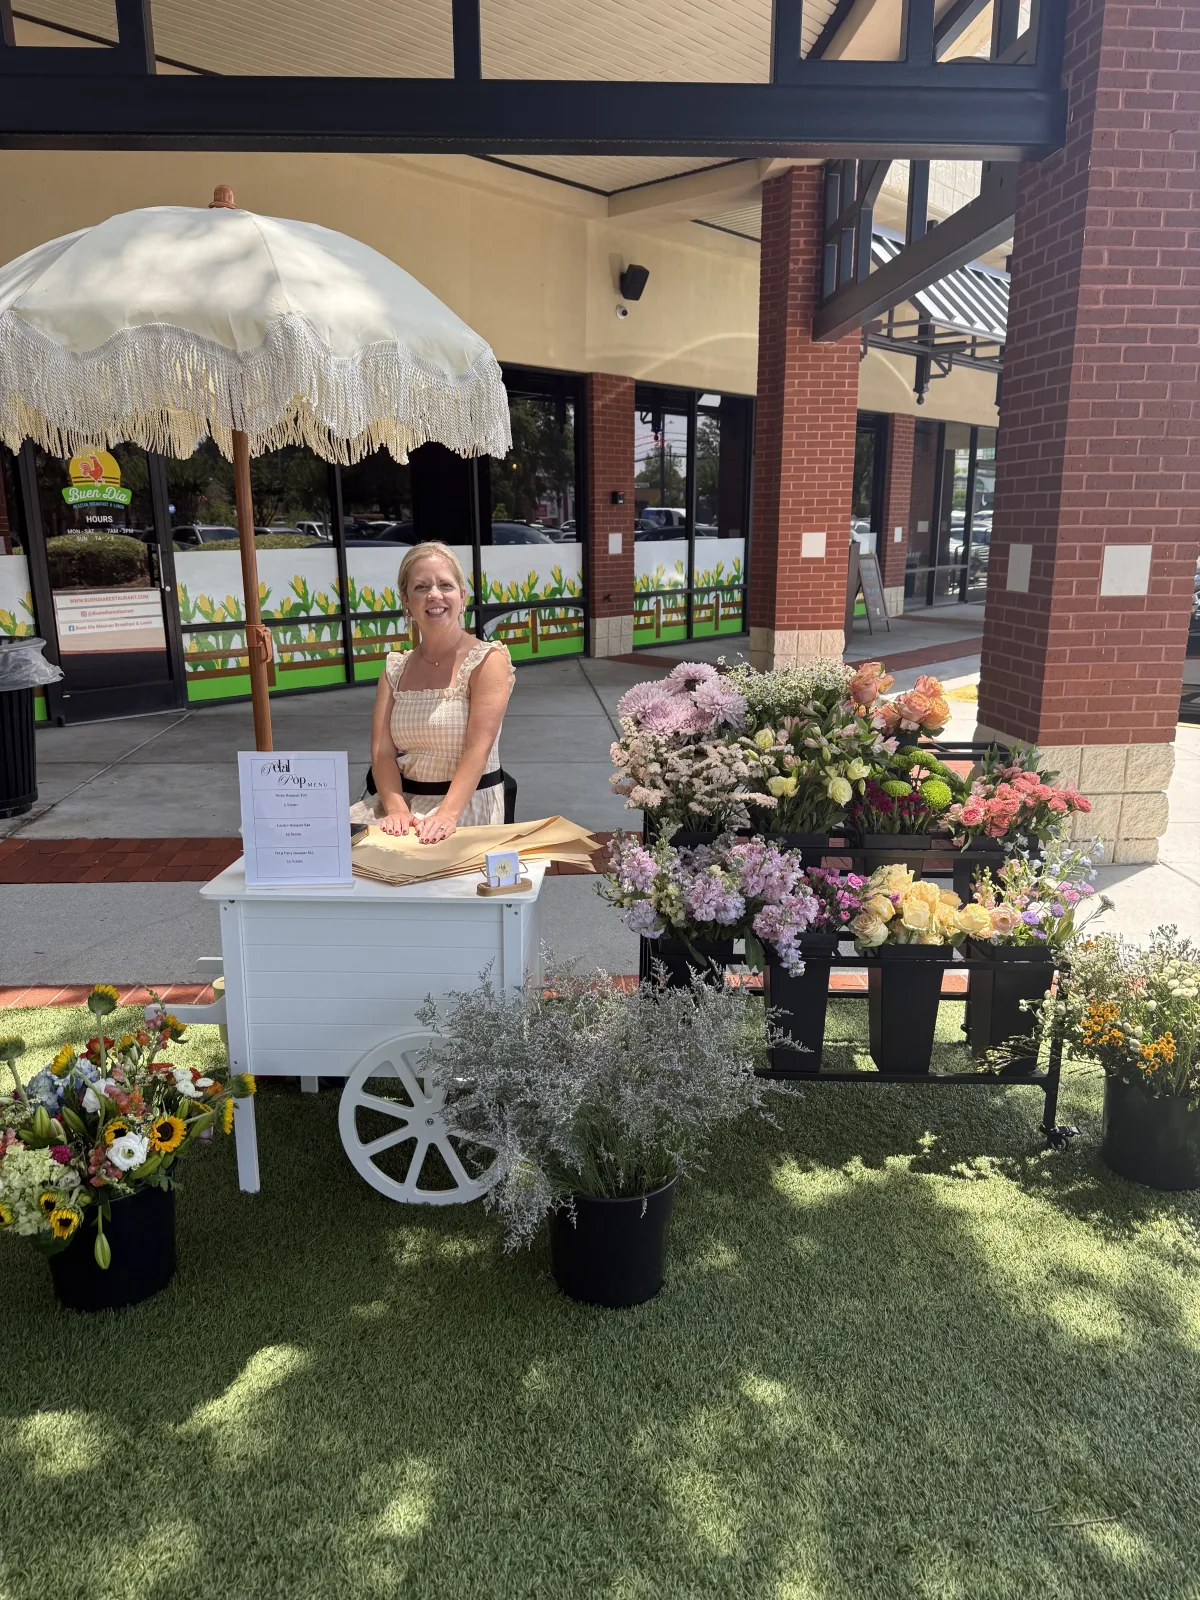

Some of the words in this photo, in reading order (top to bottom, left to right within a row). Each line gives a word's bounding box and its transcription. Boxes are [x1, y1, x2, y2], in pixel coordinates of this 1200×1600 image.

[68, 487, 101, 502] Buen
[86, 515, 113, 523] HOURS
[69, 594, 149, 603] WWW.BUENDIARESTAURANT.COM
[278, 774, 306, 788] Pop
